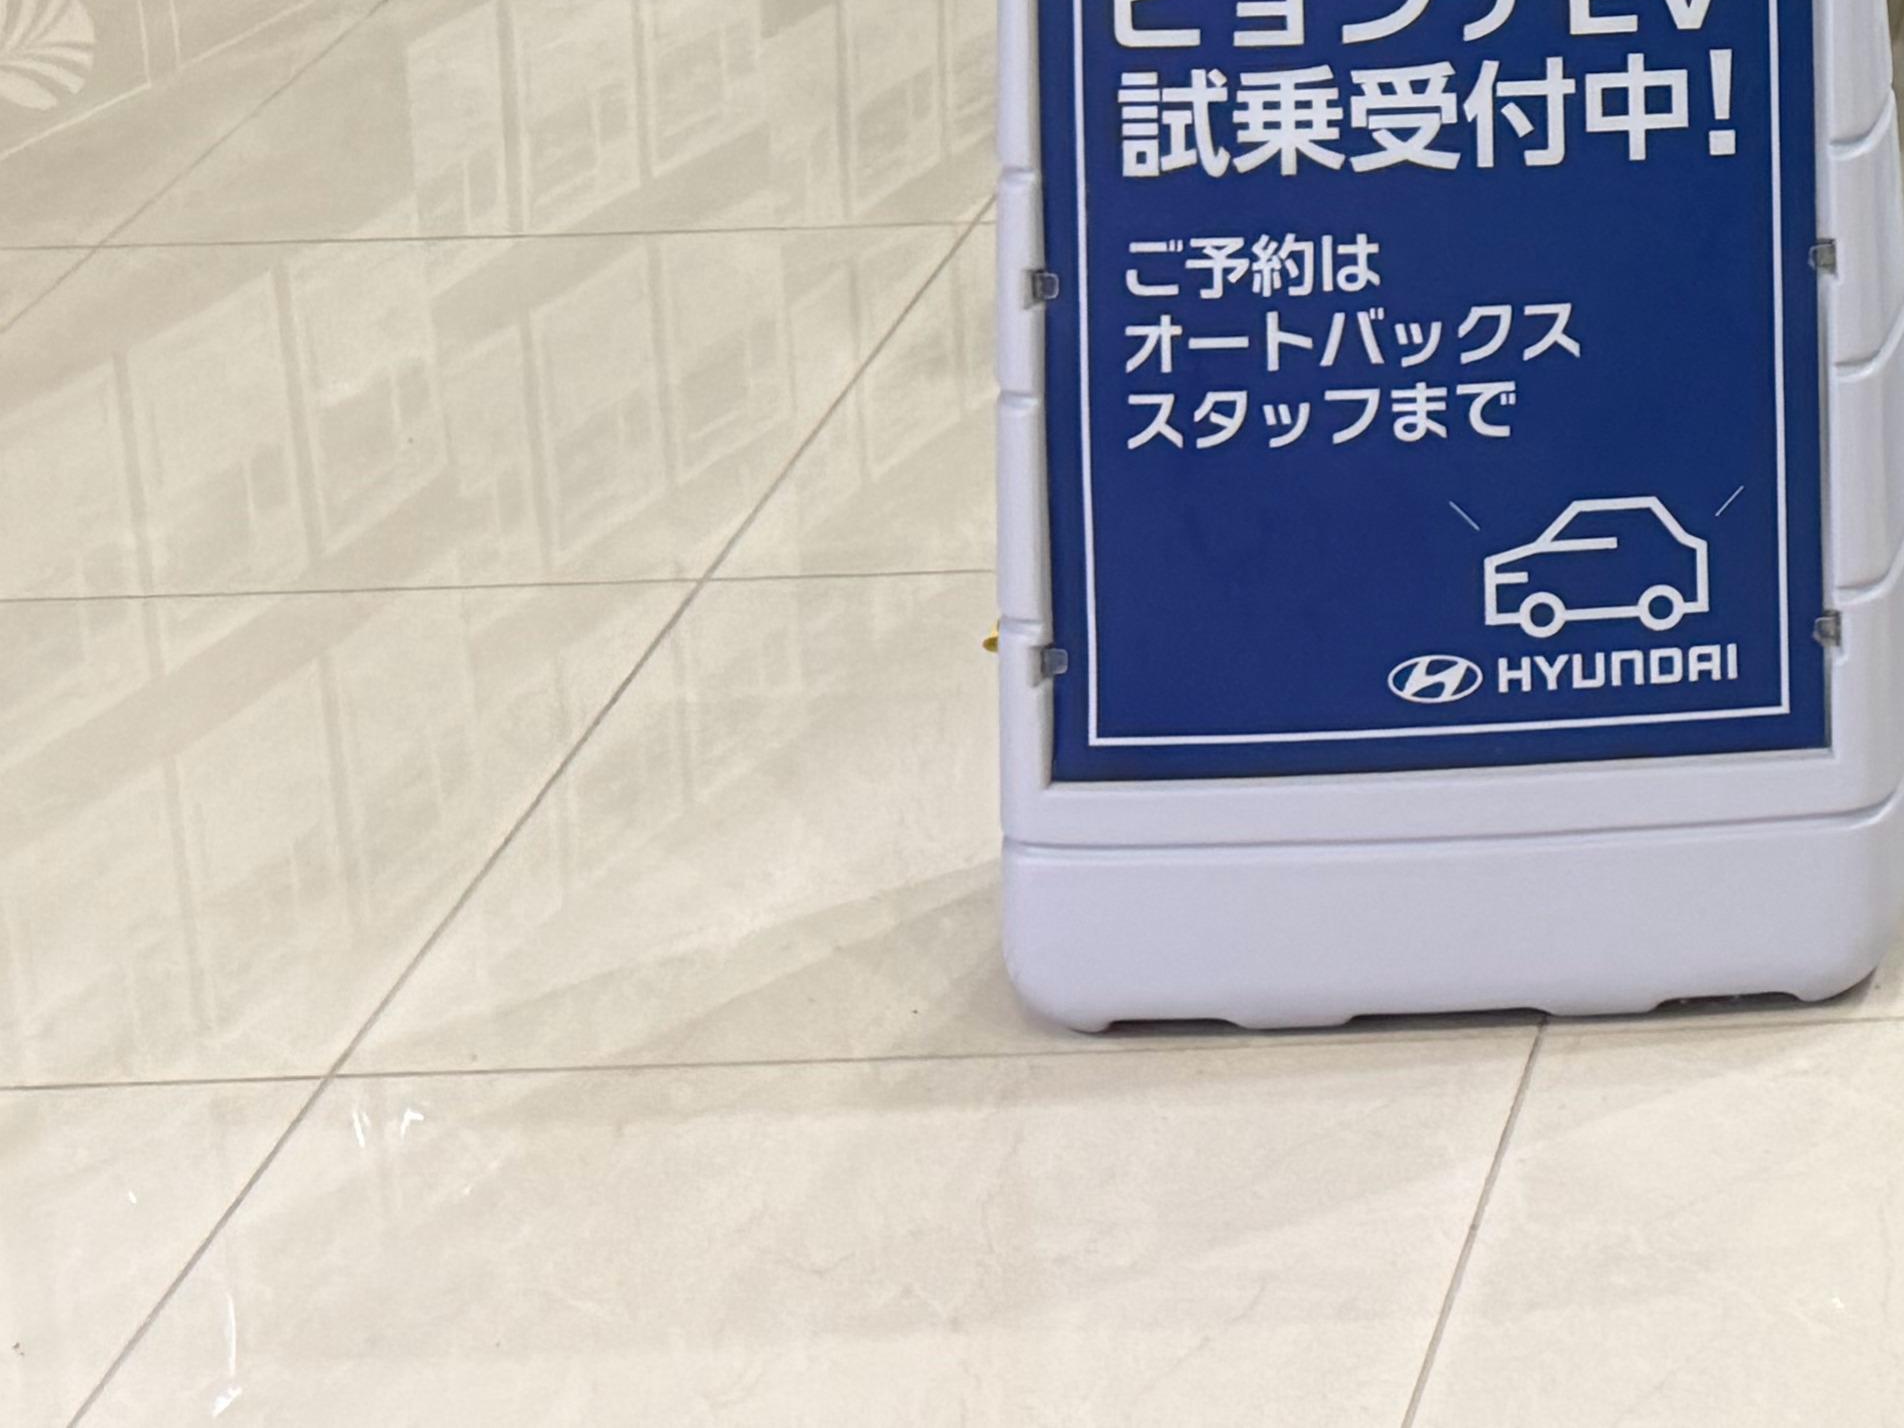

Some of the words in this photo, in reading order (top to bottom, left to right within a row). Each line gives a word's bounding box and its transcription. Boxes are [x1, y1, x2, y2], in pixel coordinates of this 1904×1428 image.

[1116, 49, 1738, 178] 試乗受付中!
[1123, 232, 1381, 299] ご予約は
[1125, 302, 1581, 373] オートバックス
[1125, 380, 1519, 451] スタッフまで
[1498, 642, 1739, 694] HYUNDAI
